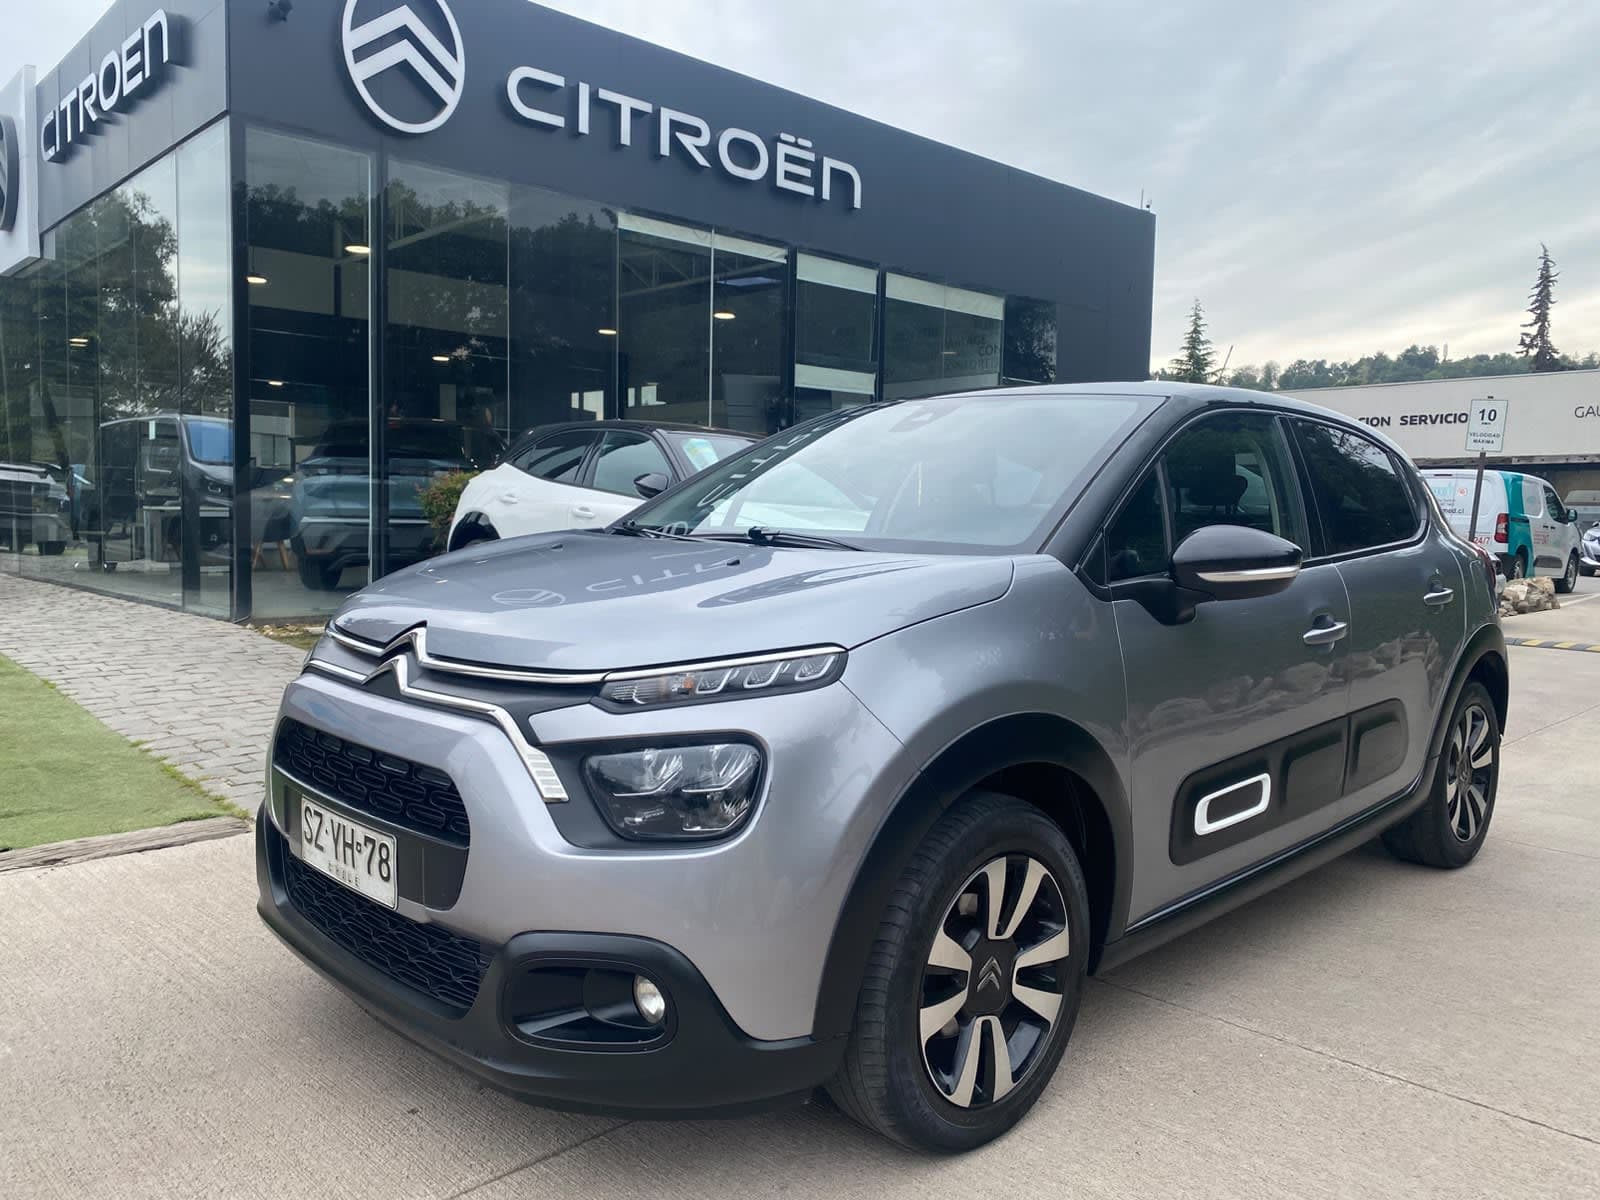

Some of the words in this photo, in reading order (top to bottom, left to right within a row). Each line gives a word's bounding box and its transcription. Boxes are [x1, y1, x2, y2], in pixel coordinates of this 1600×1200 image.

[507, 66, 862, 209] CITROËN
[1399, 412, 1469, 426] SERVICIO
[1478, 408, 1498, 422] 10
